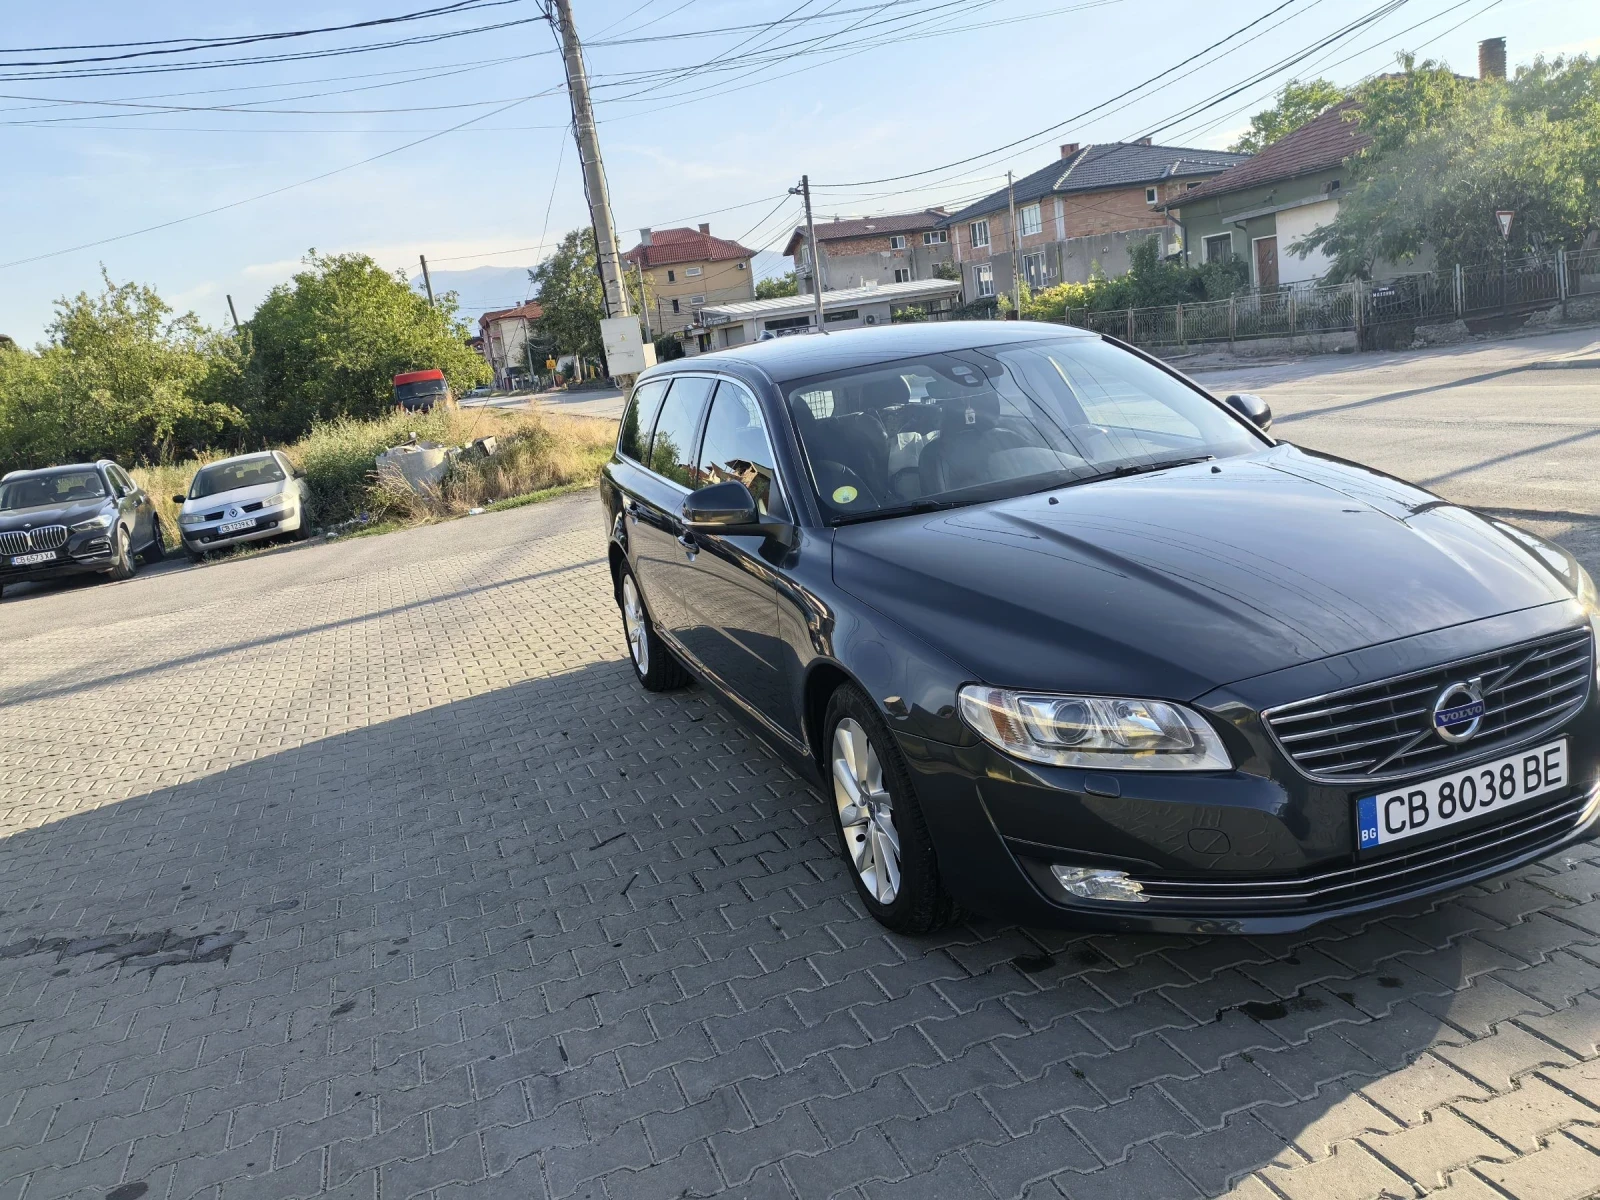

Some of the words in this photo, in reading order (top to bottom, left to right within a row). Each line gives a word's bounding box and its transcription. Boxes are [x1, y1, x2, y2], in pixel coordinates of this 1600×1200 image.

[1439, 705, 1482, 722] VOLVO
[1384, 790, 1429, 834] CB
[1438, 763, 1516, 819] 8038
[1523, 746, 1562, 794] BE
[1361, 827, 1377, 842] BG
